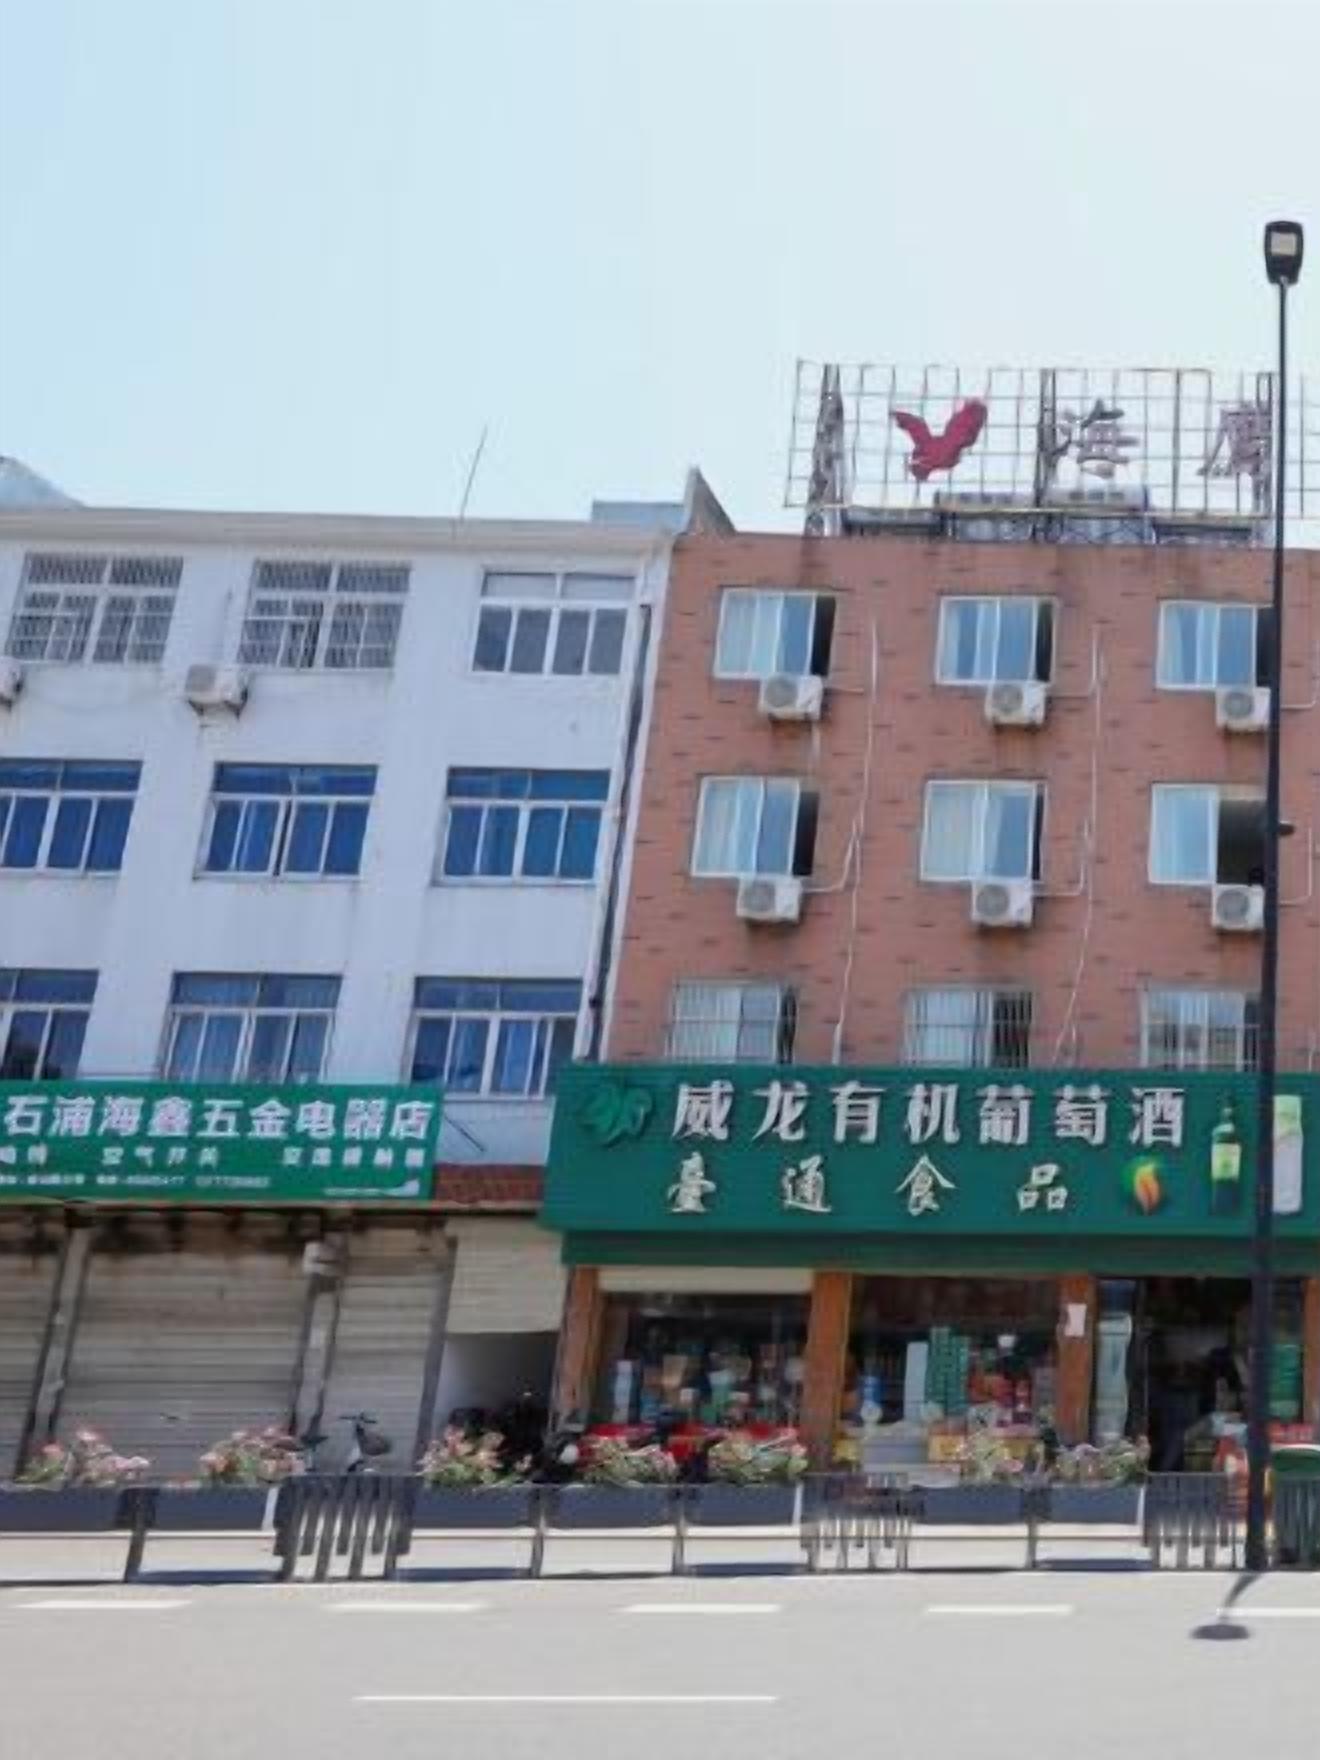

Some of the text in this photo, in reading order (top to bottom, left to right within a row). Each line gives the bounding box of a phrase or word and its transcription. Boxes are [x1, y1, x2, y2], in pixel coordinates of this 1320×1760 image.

[4, 1095, 435, 1140] 石浦海鑫五金电器店
[670, 1080, 1186, 1147] 威龙有机葡萄酒
